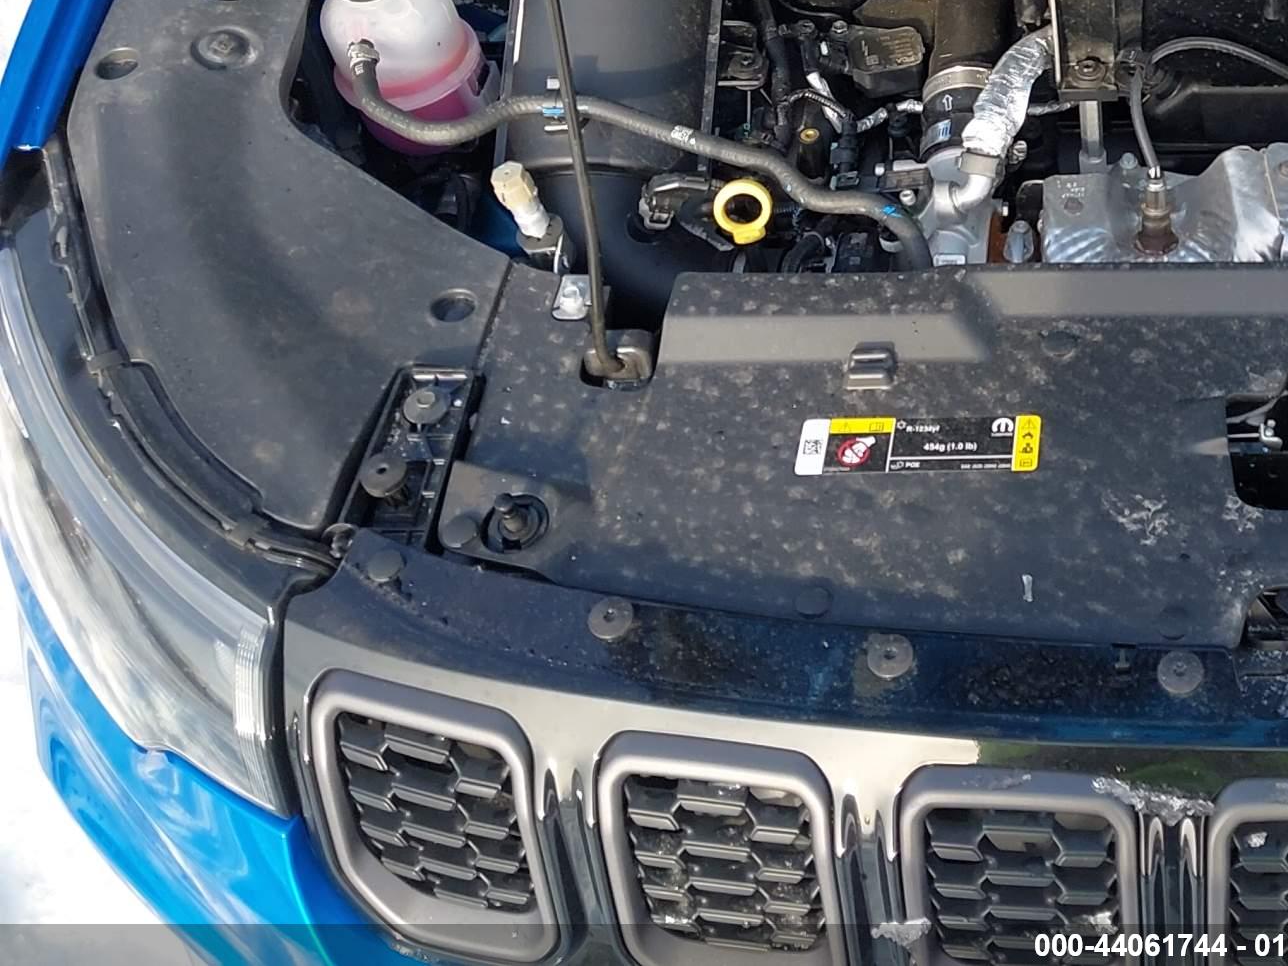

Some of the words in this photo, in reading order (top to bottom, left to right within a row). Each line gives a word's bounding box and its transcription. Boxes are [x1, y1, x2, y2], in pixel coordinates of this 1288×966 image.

[923, 442, 945, 452] 454g
[947, 442, 964, 452] (1.0
[965, 442, 977, 451] lb)
